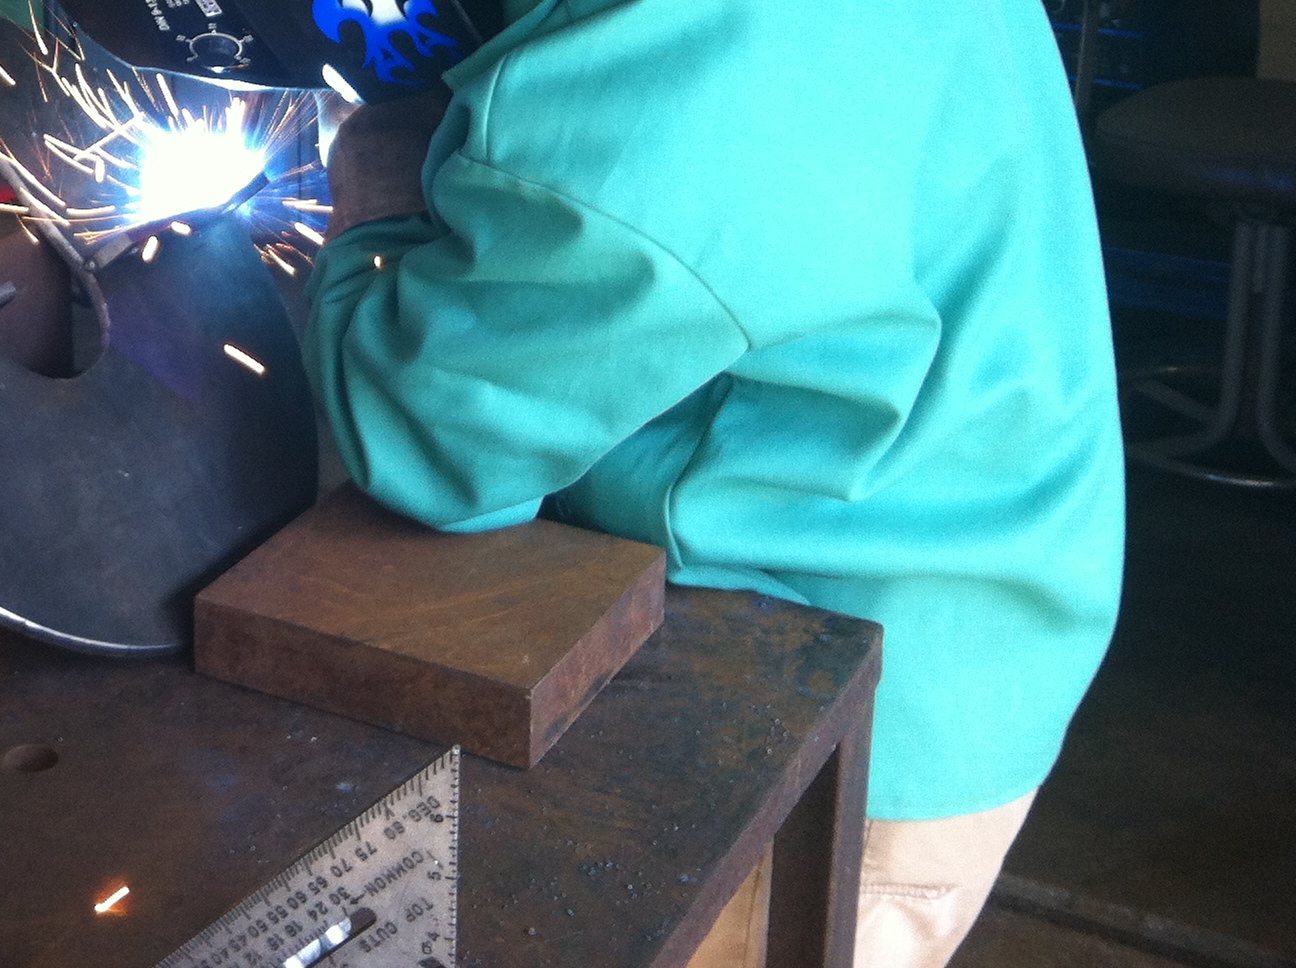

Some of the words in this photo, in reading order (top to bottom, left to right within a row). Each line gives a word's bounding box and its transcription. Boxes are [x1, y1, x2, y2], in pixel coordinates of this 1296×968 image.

[355, 841, 377, 861] 75
[330, 858, 353, 878] 70
[364, 850, 424, 896] COMMON
[307, 876, 328, 895] 65
[286, 891, 307, 910] 60
[328, 887, 351, 905] 30
[266, 905, 289, 924] 55
[308, 901, 328, 921] 24
[405, 896, 434, 923] TOP
[247, 919, 268, 938] 50
[358, 921, 398, 953] CUTS
[228, 934, 247, 952] 45
